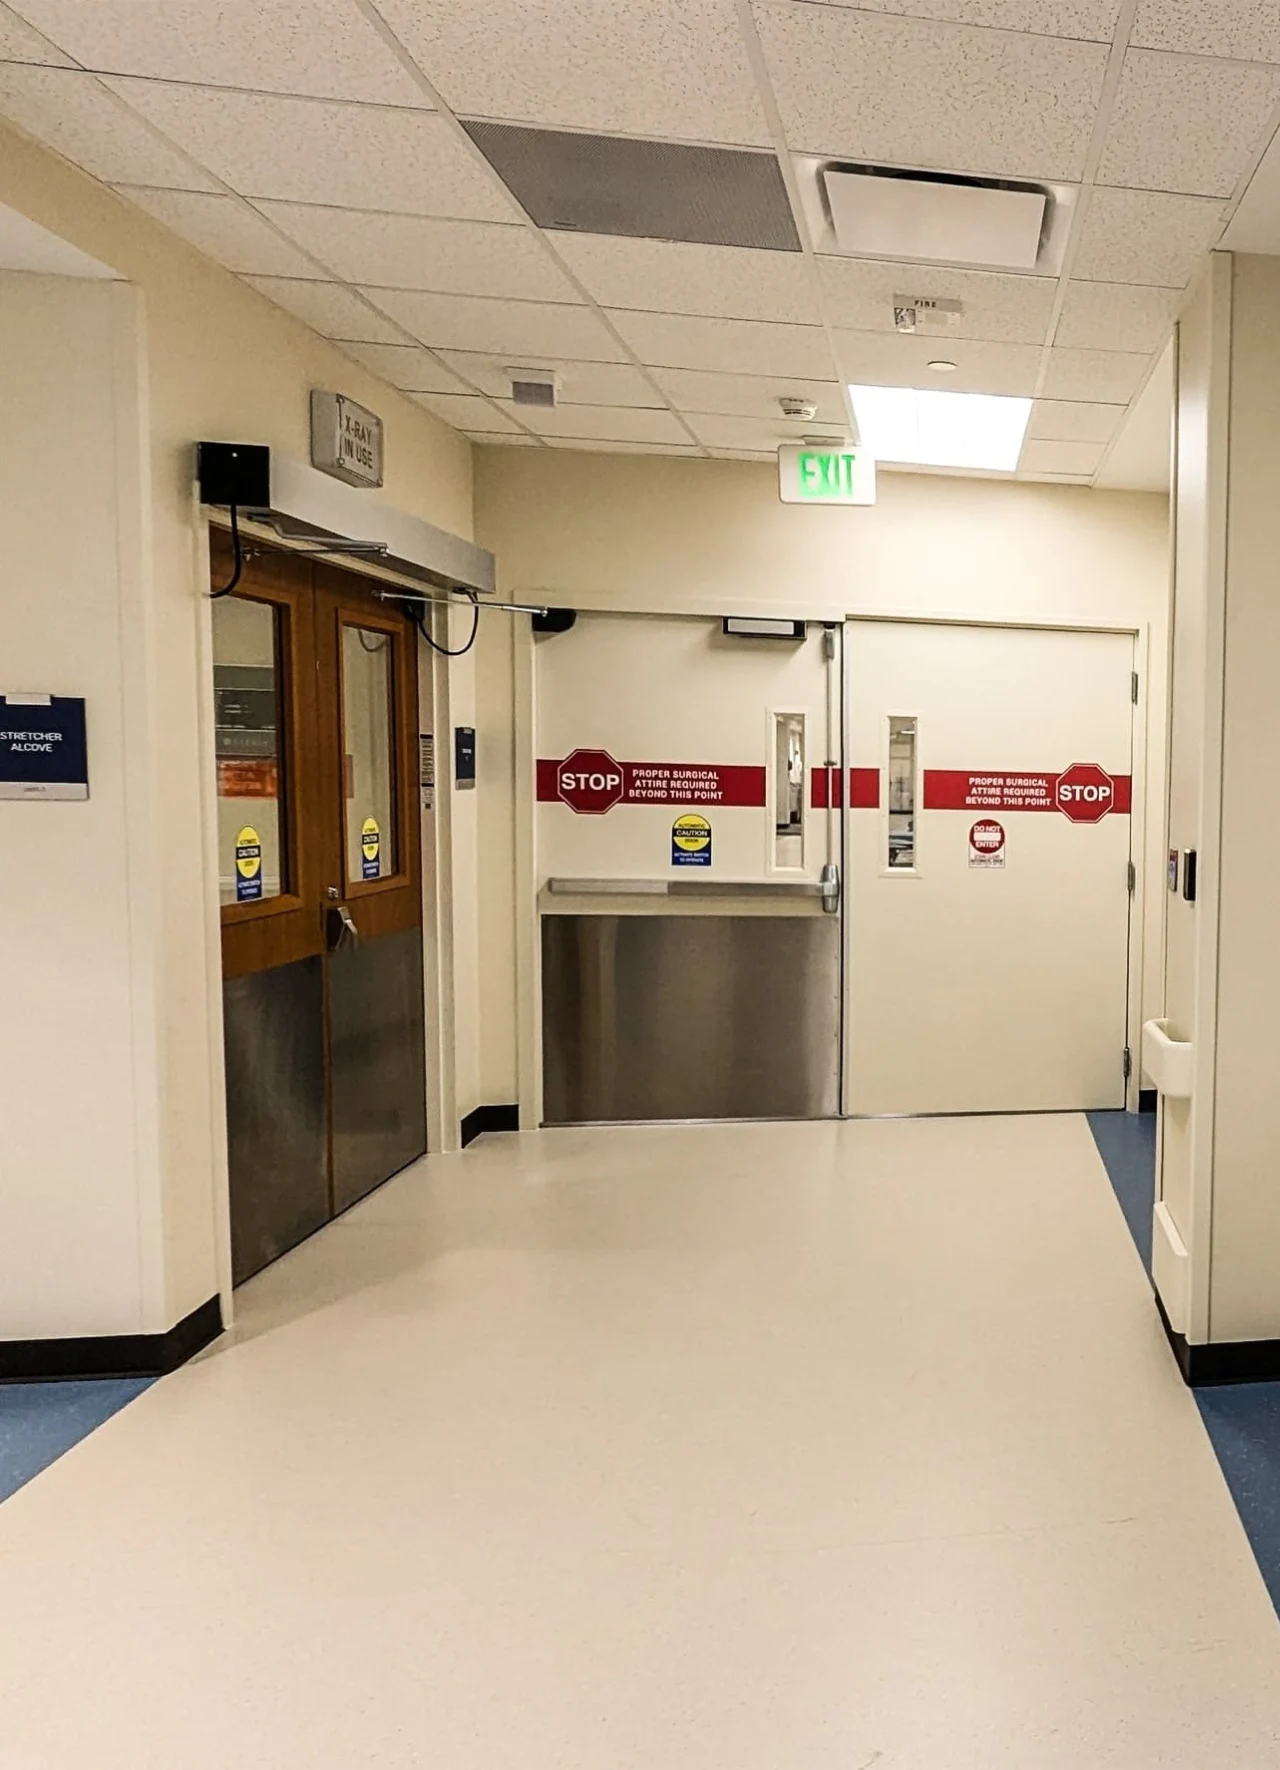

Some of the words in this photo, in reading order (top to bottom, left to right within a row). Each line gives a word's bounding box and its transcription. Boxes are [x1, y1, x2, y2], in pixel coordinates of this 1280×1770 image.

[914, 299, 937, 308] FIRE
[345, 414, 372, 445] X-RAY
[344, 438, 354, 458] IN
[355, 445, 373, 470] USE
[799, 451, 856, 497] EXIT
[0, 731, 63, 741] STRETCHER
[10, 743, 53, 752] ALCOVE
[632, 769, 670, 779] PROPER
[672, 770, 719, 780] SURGICAL
[561, 773, 620, 791] STOP
[634, 780, 668, 789] ATTIRE
[670, 780, 717, 790] REQUIRED
[968, 777, 1004, 786] PROPER
[1005, 778, 1048, 787] SURGICAL
[628, 789, 668, 799] BEYOND
[670, 790, 692, 799] THIS
[694, 791, 723, 800] POINT
[971, 786, 1001, 796] ATTIRE
[1003, 787, 1046, 797] REQUIRED
[1060, 785, 1111, 801] STOP
[965, 796, 1001, 805] BEYOND
[1003, 797, 1023, 806] THIS
[1024, 798, 1052, 806] POINT
[676, 829, 708, 837] CAUTION
